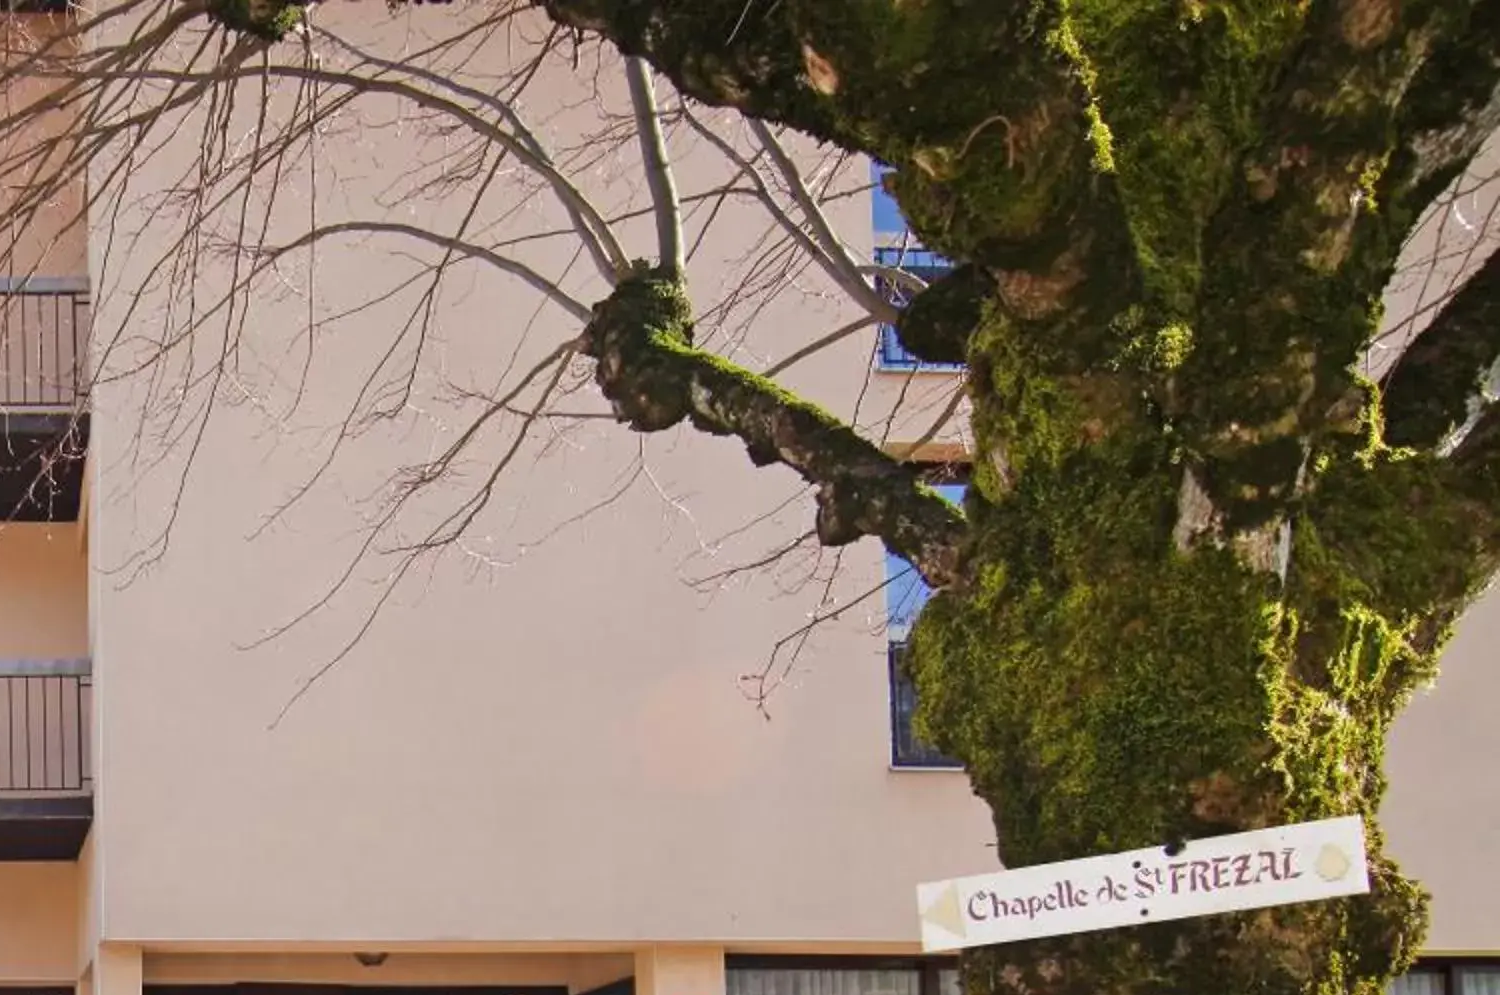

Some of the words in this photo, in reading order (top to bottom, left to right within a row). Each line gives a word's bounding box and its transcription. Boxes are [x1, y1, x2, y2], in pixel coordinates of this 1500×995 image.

[968, 880, 1088, 921] Chapelle
[1096, 875, 1128, 901] de
[1168, 847, 1302, 894] FREZAL
